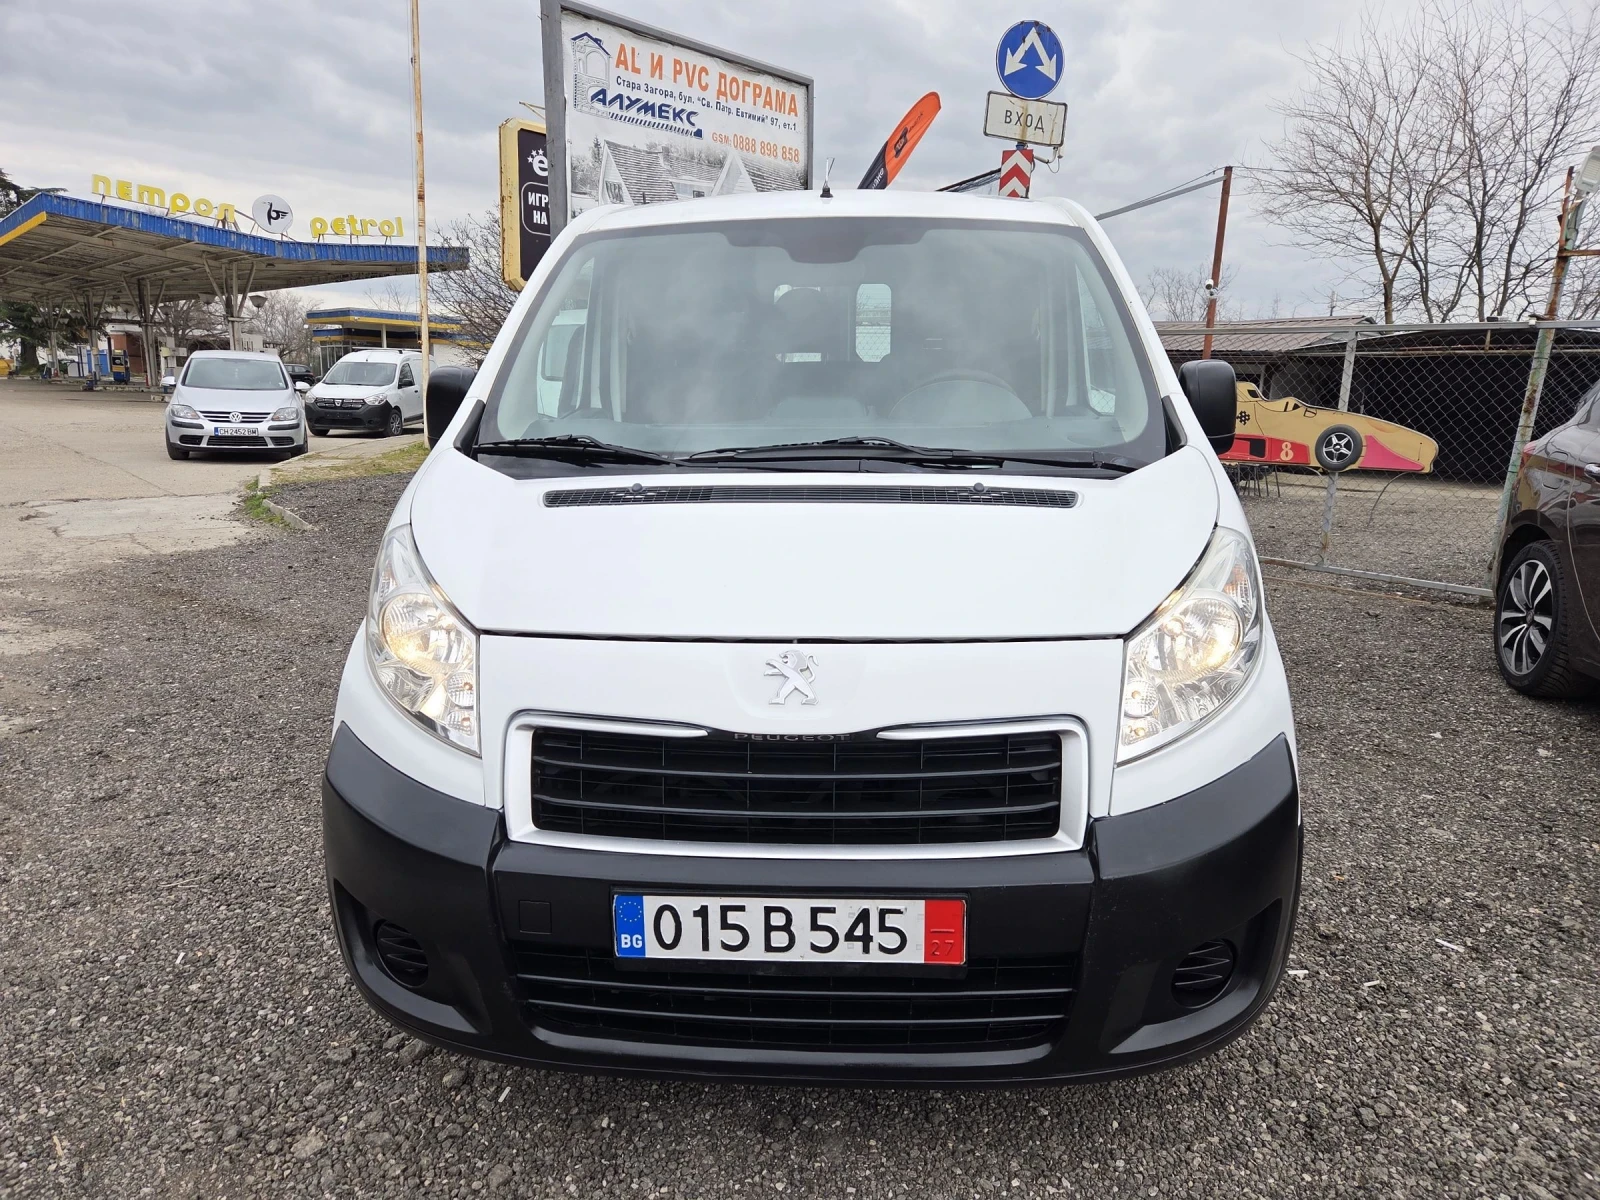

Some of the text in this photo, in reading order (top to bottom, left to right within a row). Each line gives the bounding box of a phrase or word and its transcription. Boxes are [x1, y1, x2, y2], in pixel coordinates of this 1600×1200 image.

[615, 43, 798, 118] AL И PVC ДОГРАМА
[590, 87, 699, 127] АЛУМЕКС
[616, 75, 641, 92] Стара
[644, 83, 676, 102] Загора,
[678, 91, 695, 104] бул.
[715, 101, 734, 116] Патр.
[770, 116, 781, 130] 97,
[1004, 109, 1044, 134] ВХОД
[711, 132, 800, 163] GSM: 0888 898 858
[528, 191, 550, 208] ИГР
[310, 214, 405, 238] petrol
[1280, 441, 1294, 461] 8
[734, 733, 850, 741] PEUGEOT
[620, 934, 643, 949] BG
